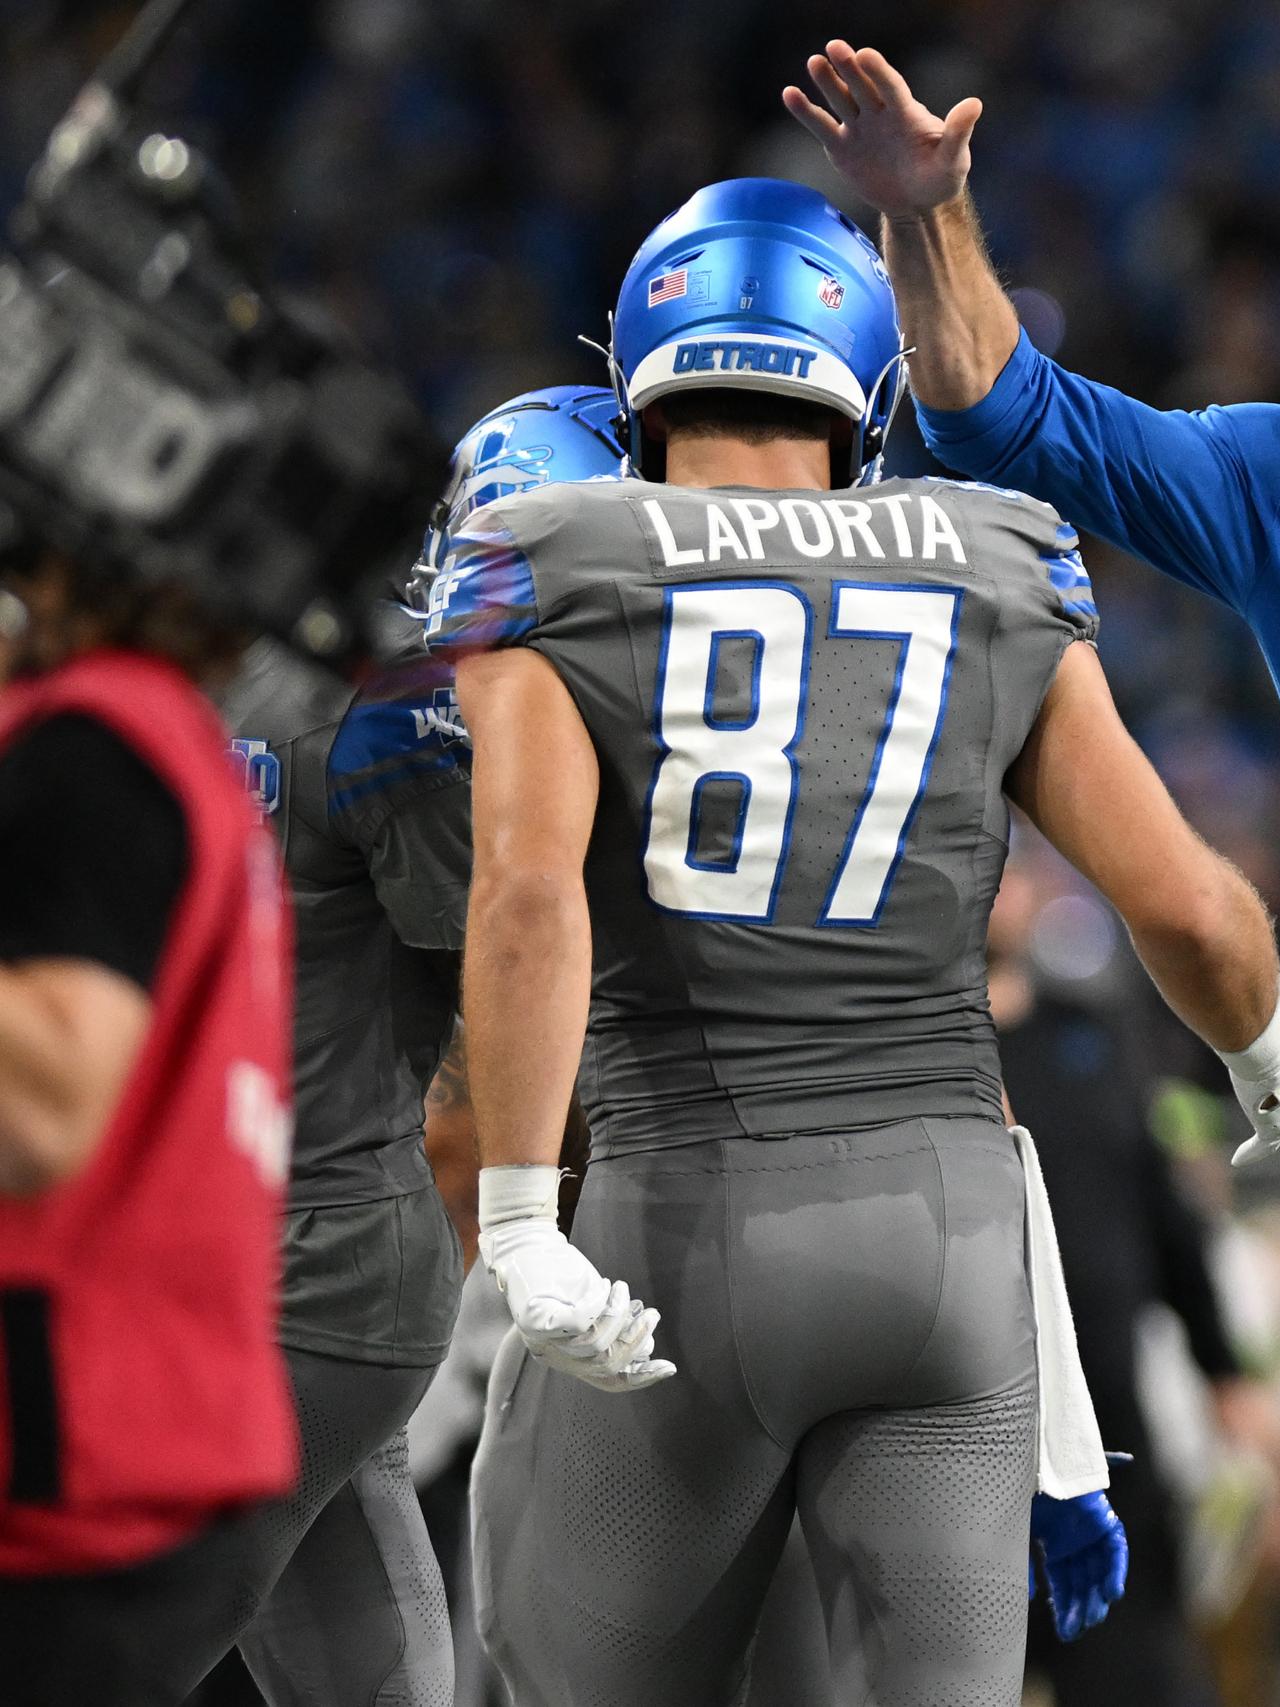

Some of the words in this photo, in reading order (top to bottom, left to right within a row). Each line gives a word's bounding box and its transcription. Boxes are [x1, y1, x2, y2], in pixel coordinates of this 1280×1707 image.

[740, 297, 754, 310] 87
[821, 287, 840, 307] NFL
[673, 342, 817, 378] DETROIT
[643, 494, 967, 566] LAPORTA
[643, 580, 965, 928] 87
